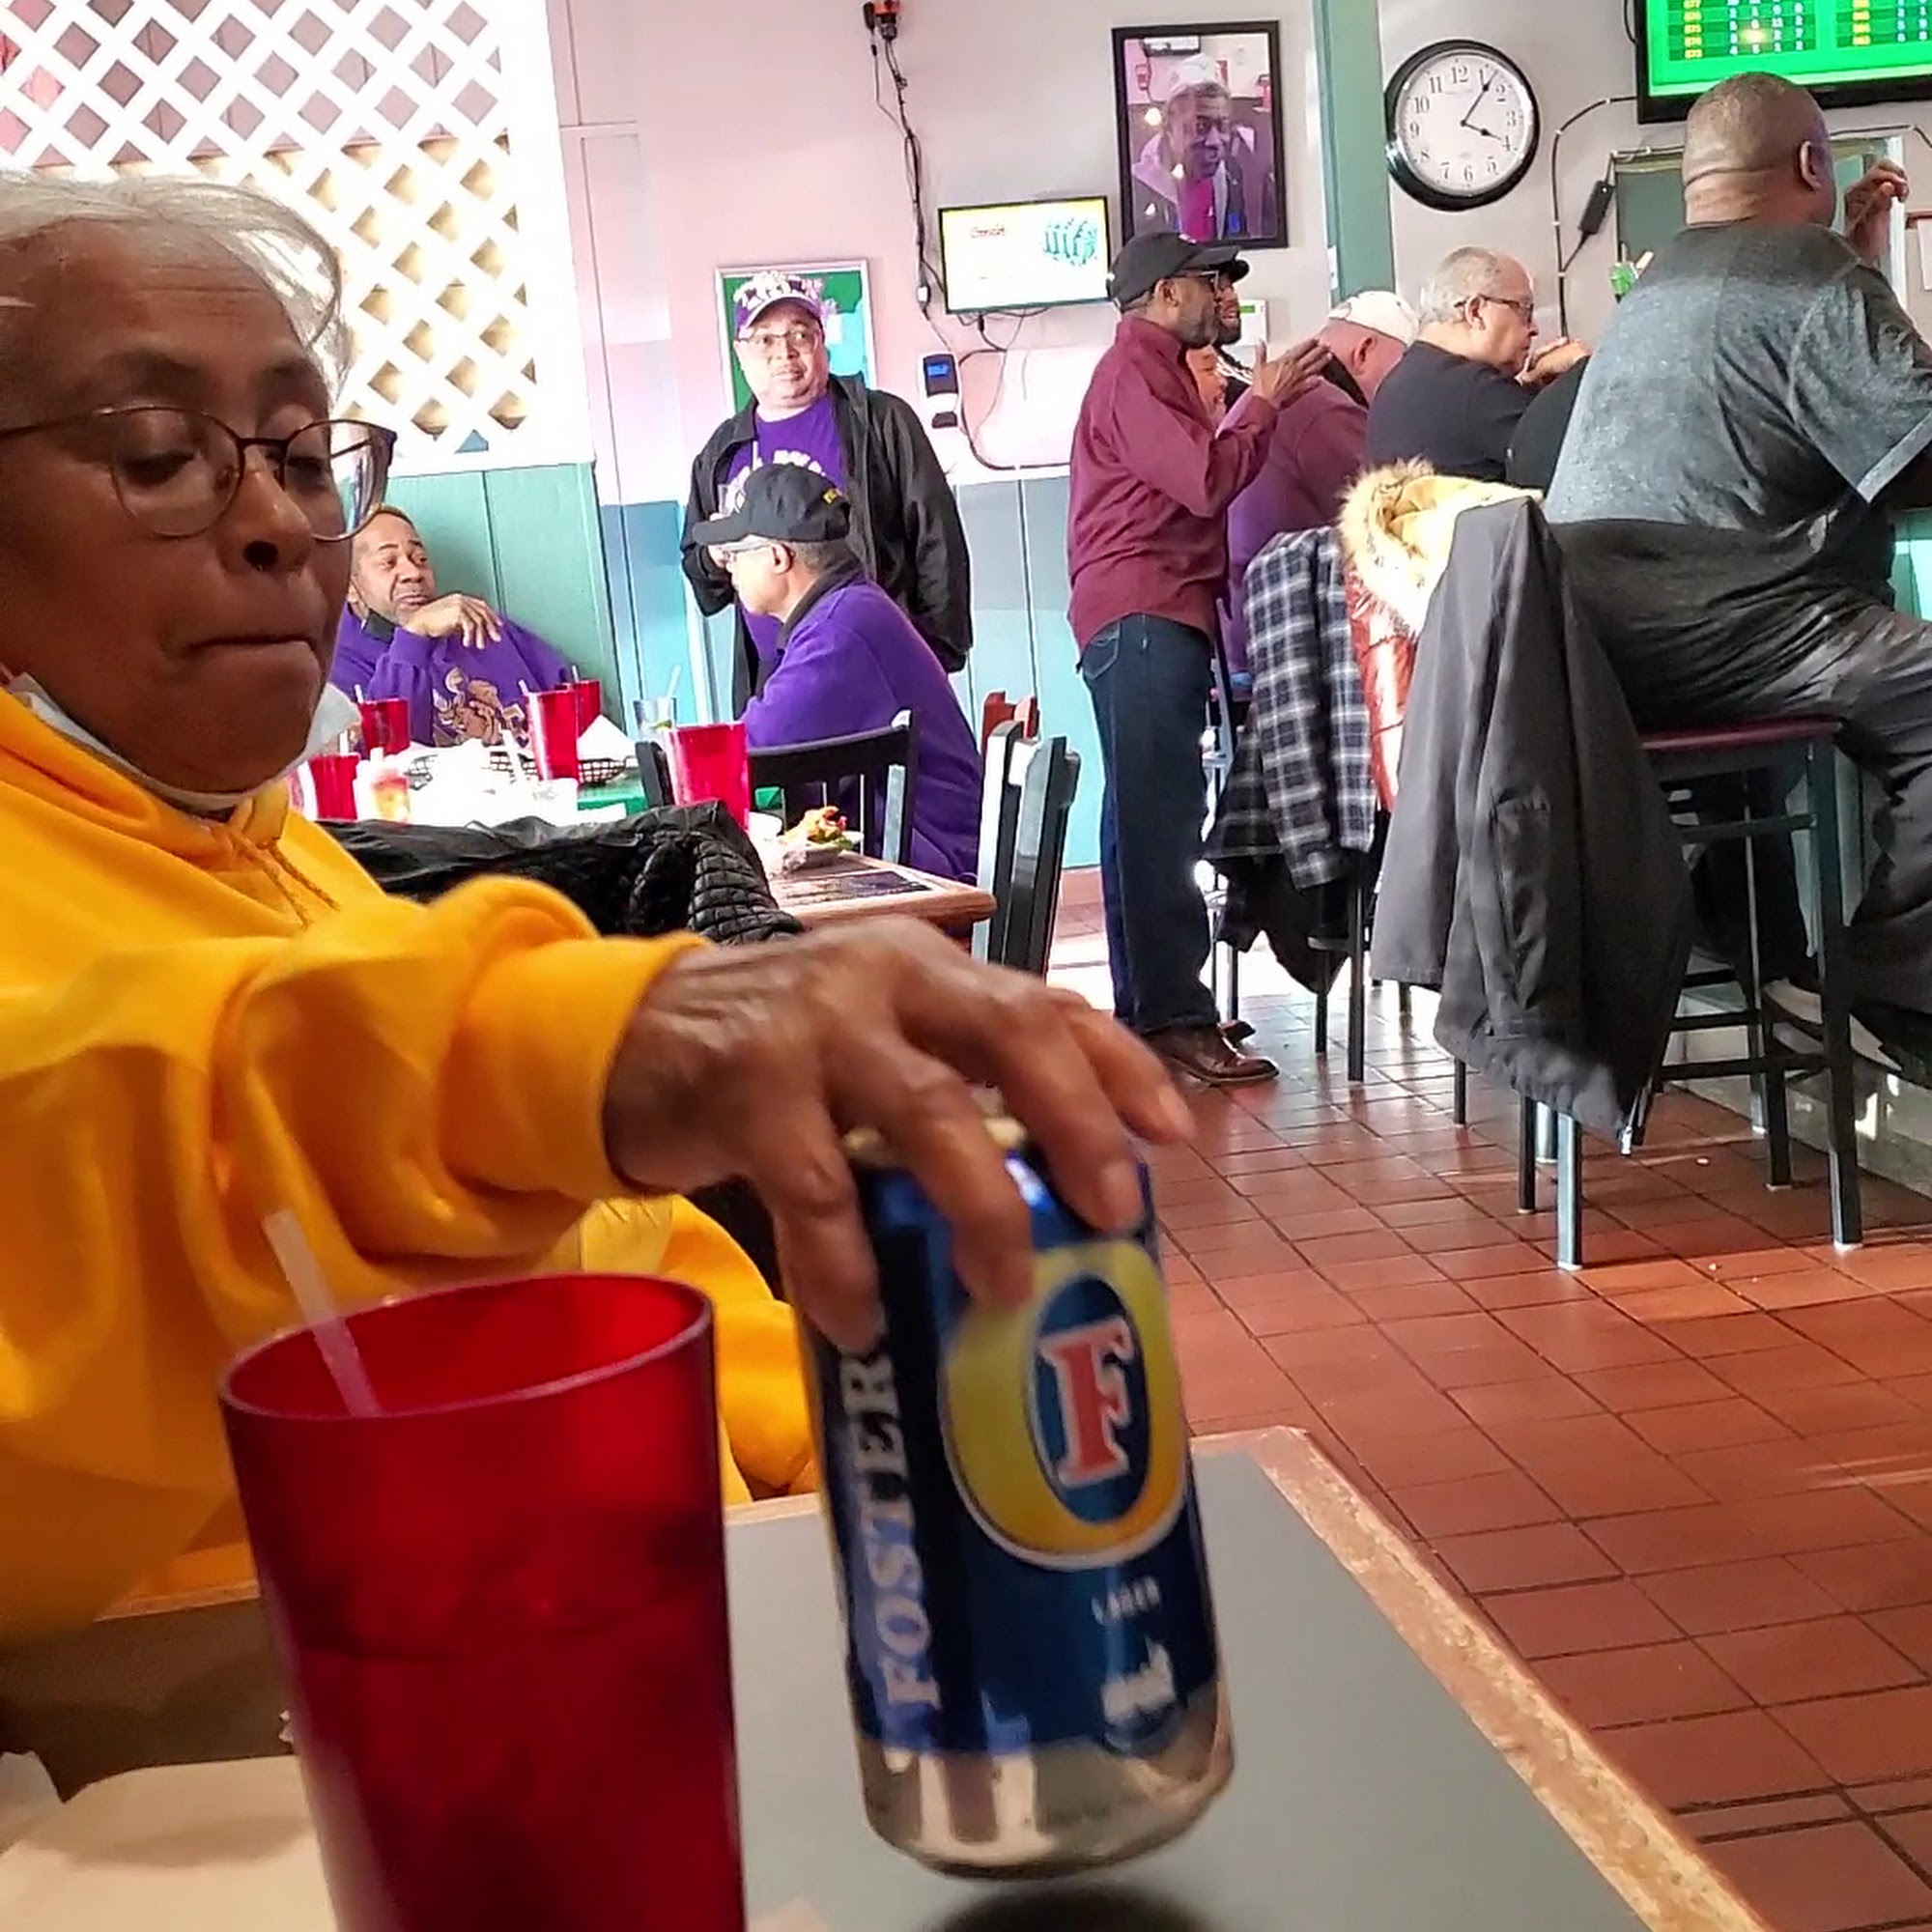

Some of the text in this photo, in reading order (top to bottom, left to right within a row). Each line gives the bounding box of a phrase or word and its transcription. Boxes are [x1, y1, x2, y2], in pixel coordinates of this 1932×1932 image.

[1450, 65, 1468, 85] 12
[1430, 76, 1442, 95] 11
[1495, 84, 1507, 103] 2
[1414, 97, 1431, 115] 10
[1506, 110, 1517, 128] 3
[1409, 122, 1421, 139] 9
[1501, 134, 1512, 152] 4
[1420, 148, 1431, 163] 8
[1440, 160, 1451, 181] 7
[1463, 165, 1474, 183] 6
[1487, 156, 1498, 174] 5
[1041, 1314, 1137, 1489] F
